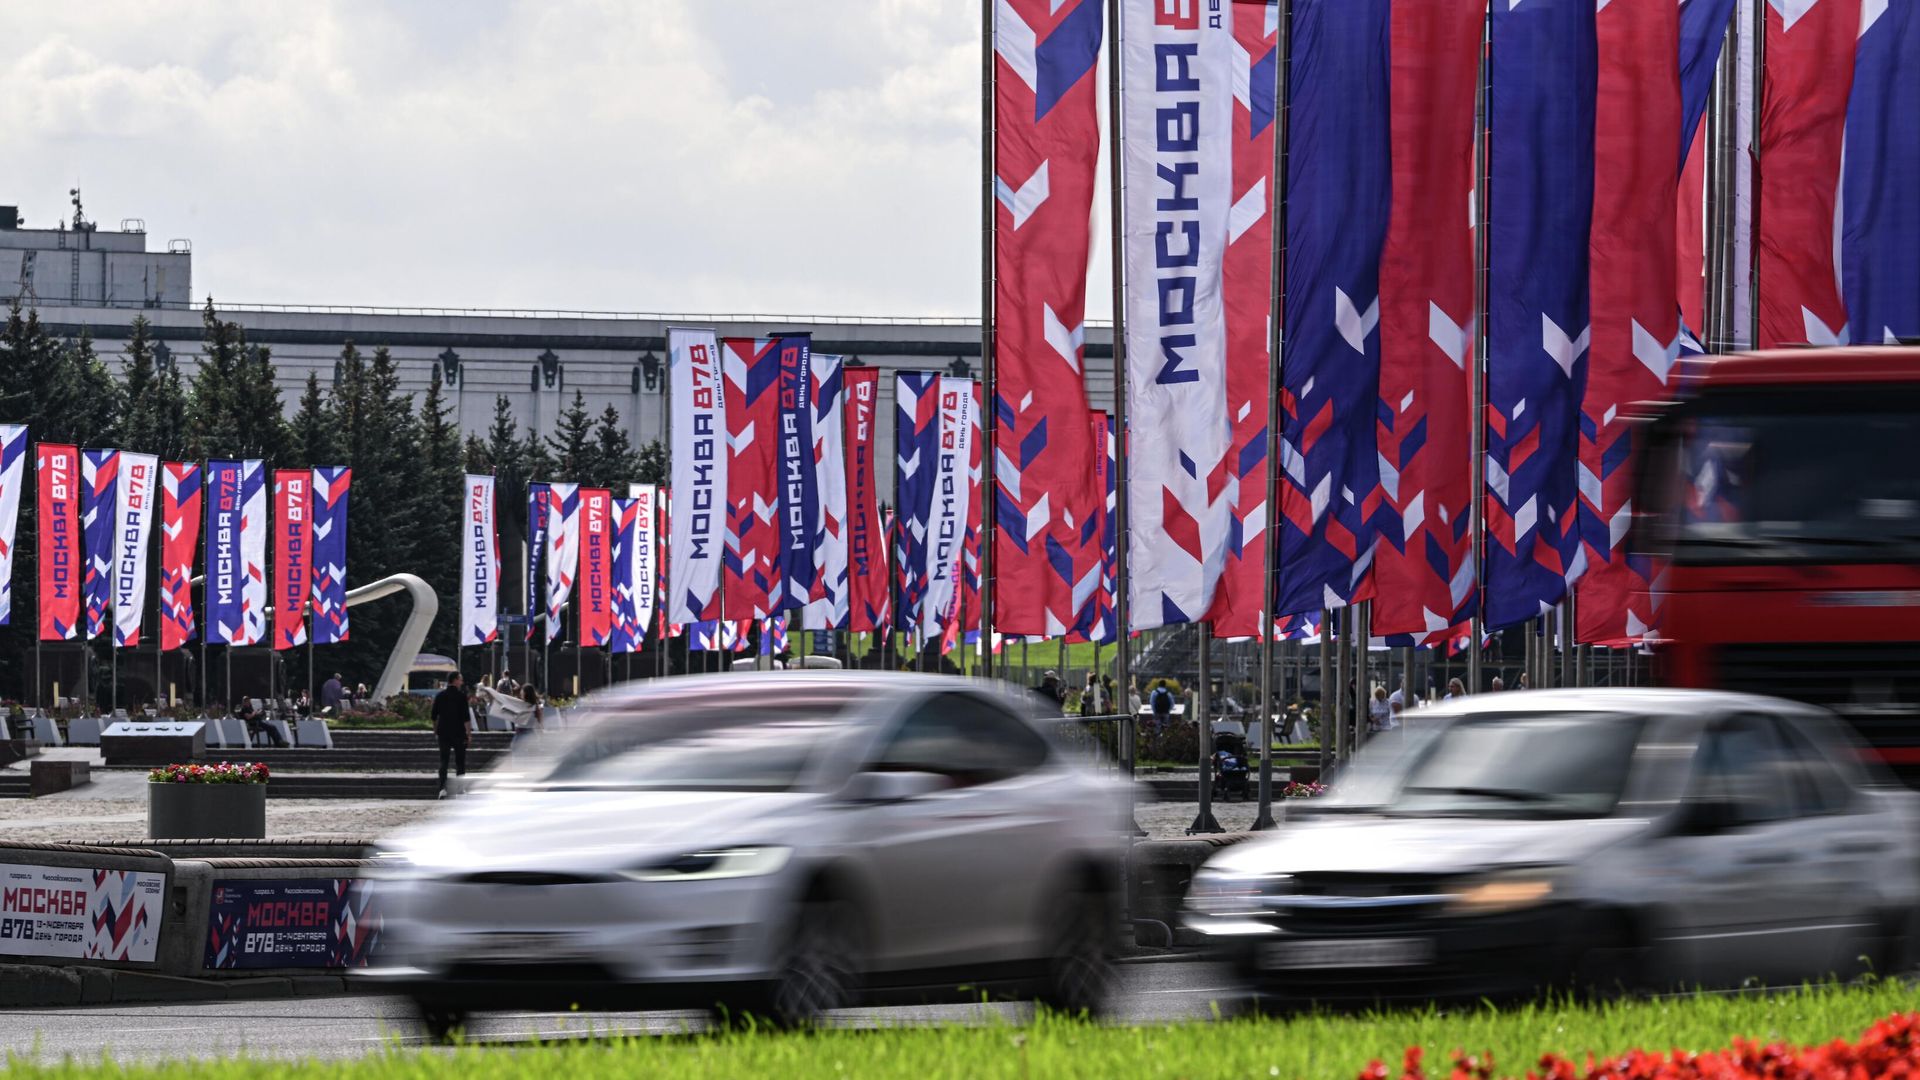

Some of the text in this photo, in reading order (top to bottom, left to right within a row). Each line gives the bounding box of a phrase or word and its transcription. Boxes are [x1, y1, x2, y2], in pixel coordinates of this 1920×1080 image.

[1154, 42, 1200, 385] МОСКВА
[800, 346, 808, 382] ГОРОДА
[942, 392, 958, 450] 878
[960, 392, 968, 426] ГОРОДА
[690, 344, 714, 559] МОСКВА 878
[780, 346, 804, 550] МОСКВА 878
[52, 455, 68, 598] МОСКВА 878
[118, 465, 145, 606] МОСКВА 878
[218, 469, 235, 604] МОСКВА 878
[288, 480, 302, 611] МОСКВА 878
[473, 486, 487, 608] МОСКВА 878
[589, 496, 602, 612] МОСКВА 878
[640, 494, 650, 608] МОСКВА 878
[0, 918, 34, 940] 878
[2, 887, 87, 916] МОСКВА
[34, 932, 83, 942] ДЕНЬ ГОРОДА
[245, 933, 274, 952] 878
[248, 902, 328, 926] МОСКВА
[274, 944, 326, 952] ДЕНЬ ГОРОДА
